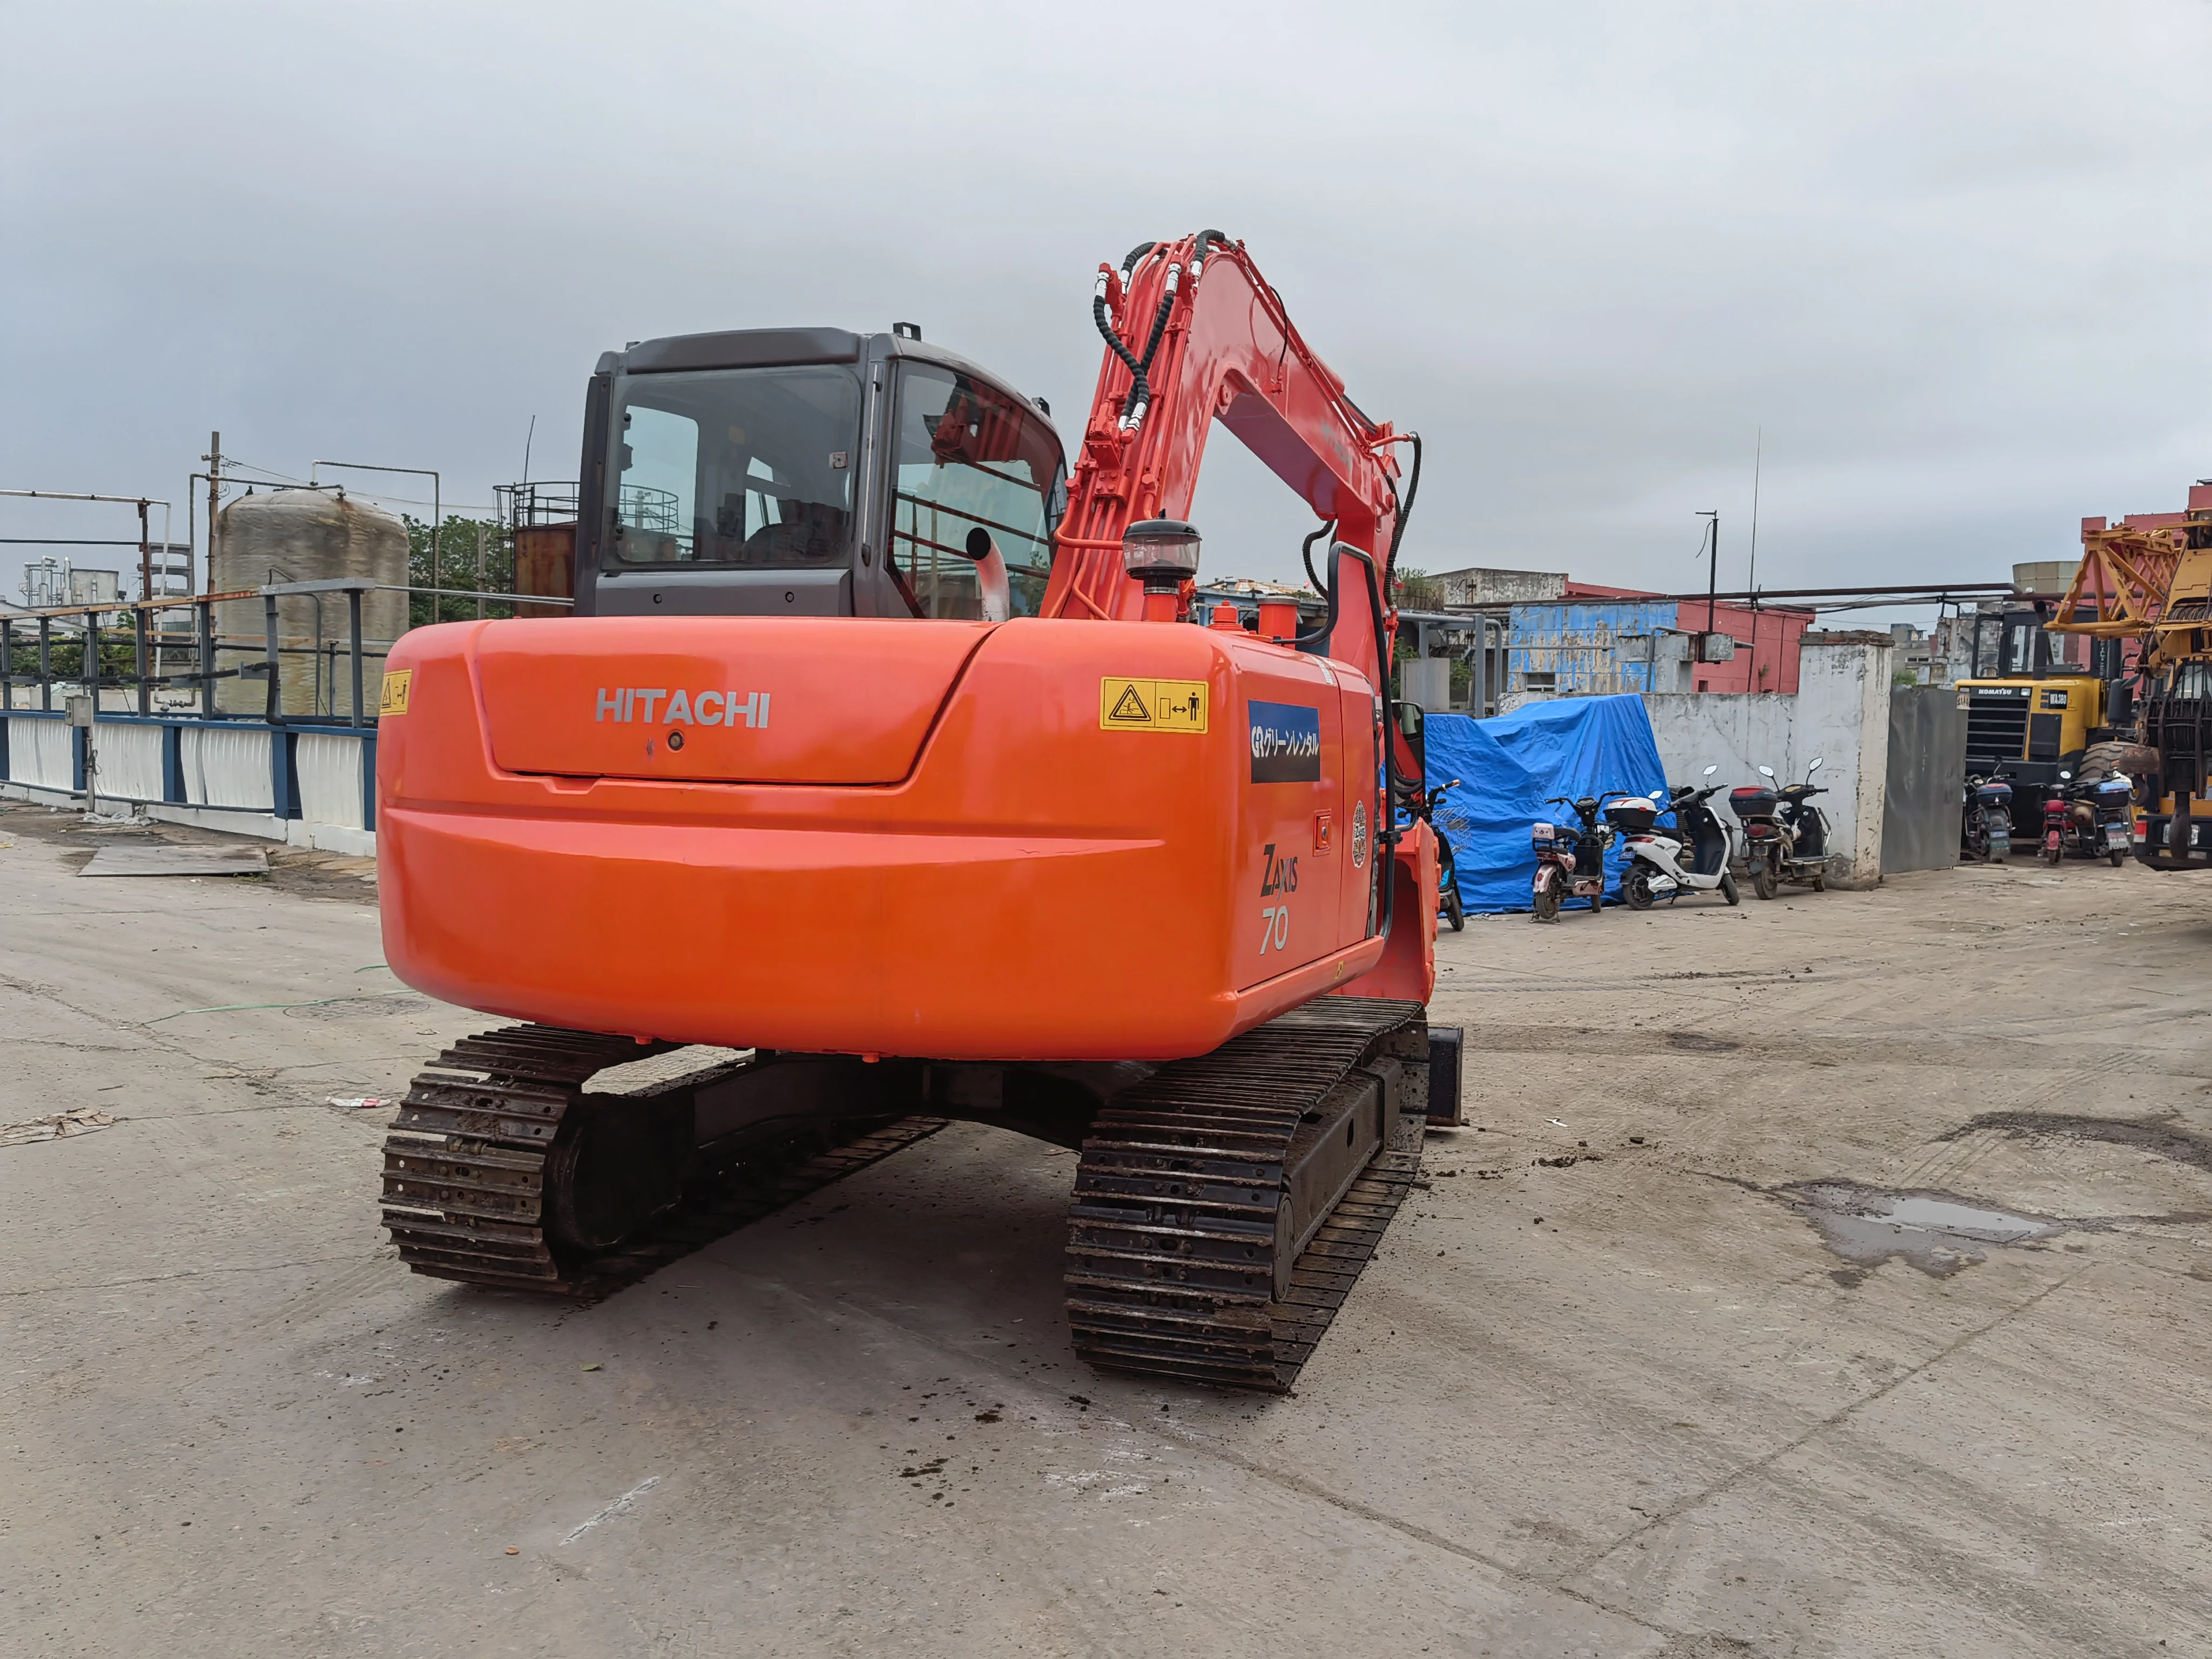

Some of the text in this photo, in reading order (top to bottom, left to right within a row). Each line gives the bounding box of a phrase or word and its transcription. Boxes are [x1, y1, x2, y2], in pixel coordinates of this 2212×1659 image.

[596, 688, 770, 728] HITACHI
[2050, 693, 2067, 705] WA380
[1264, 727, 1319, 758] グリーンレンタル
[1259, 905, 1289, 956] 70
